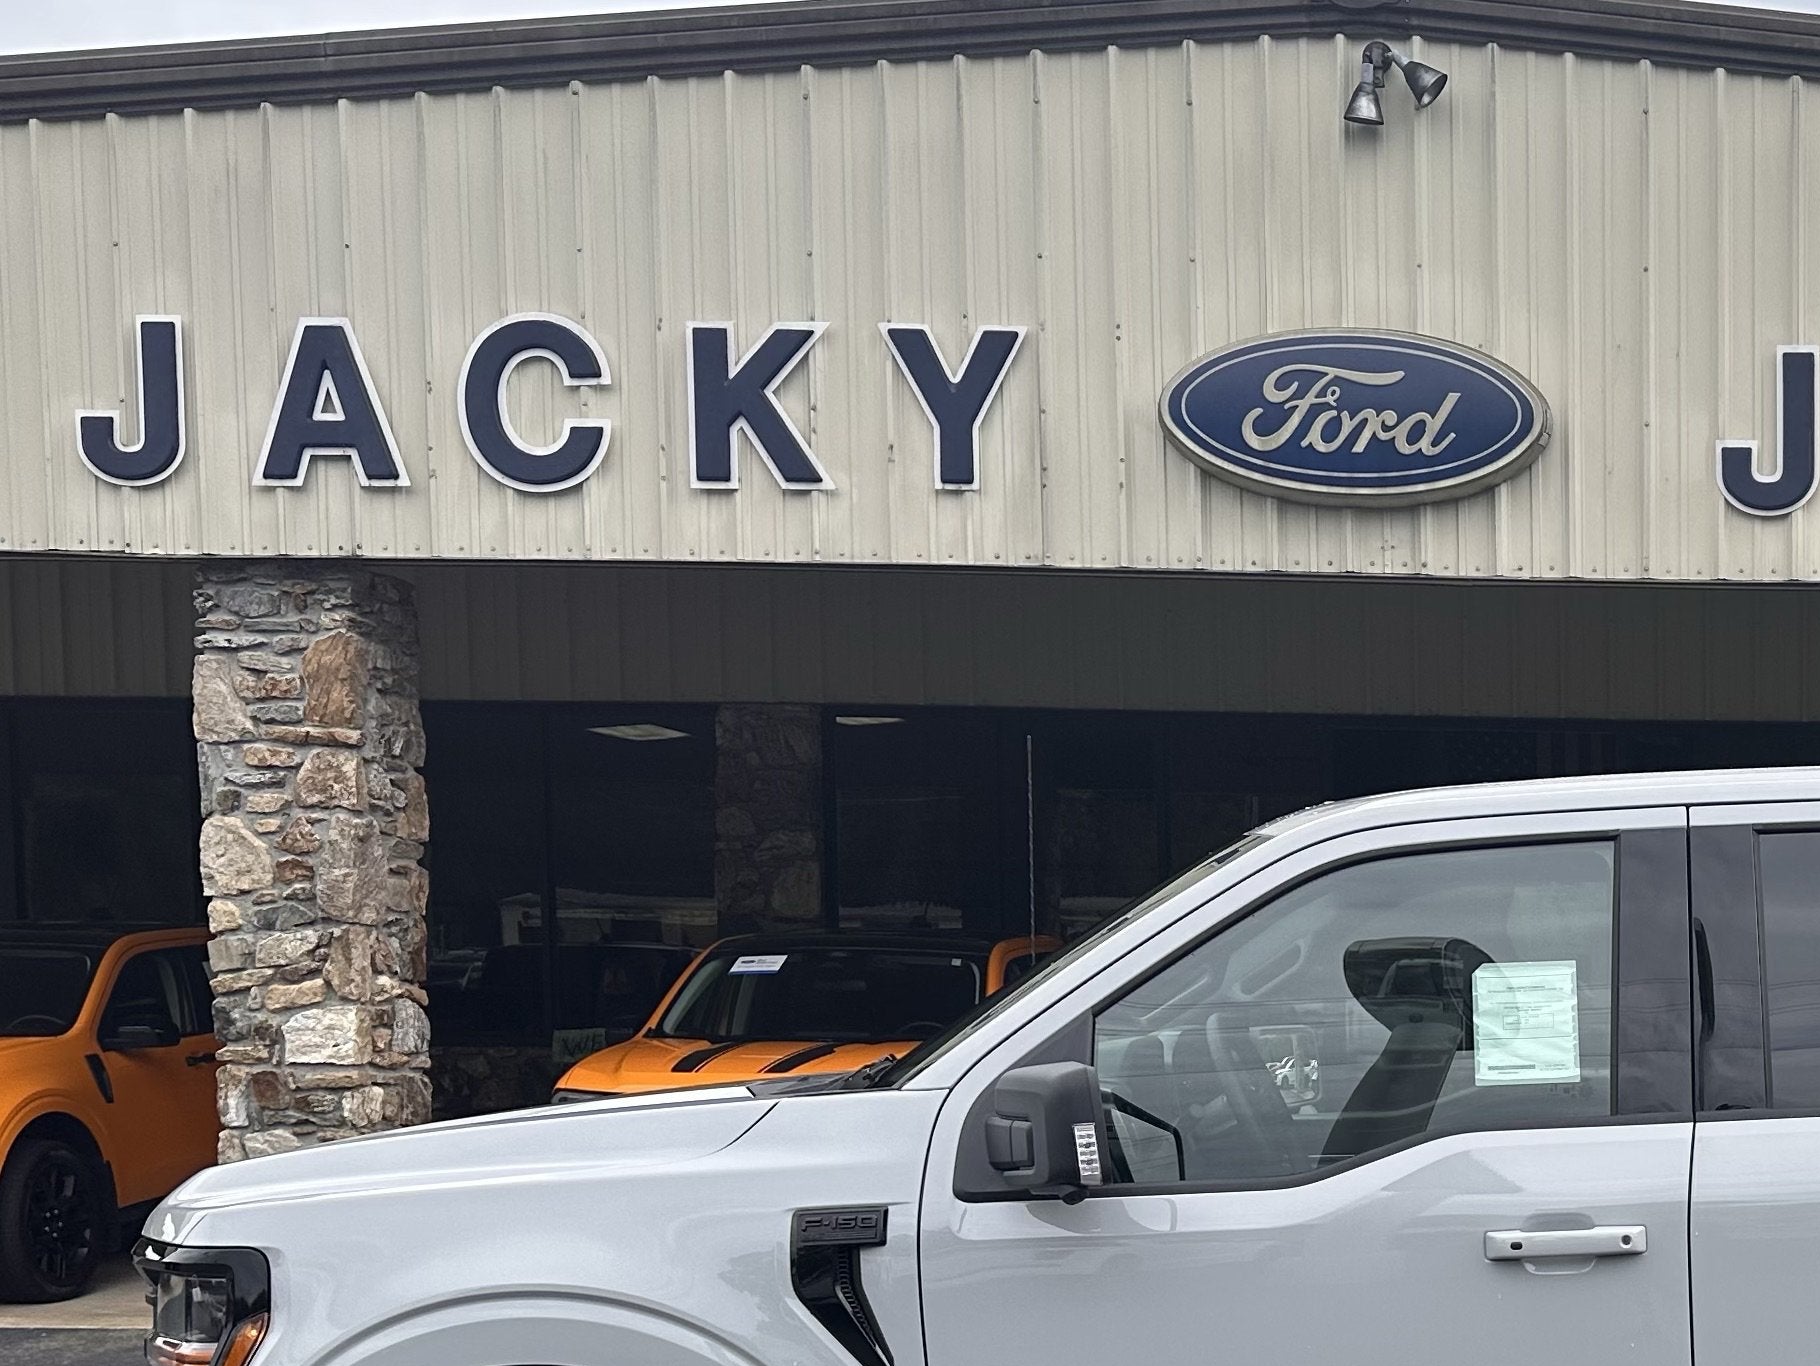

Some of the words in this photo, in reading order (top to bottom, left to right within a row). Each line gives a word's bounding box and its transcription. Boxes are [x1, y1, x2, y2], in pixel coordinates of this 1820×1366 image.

[75, 312, 1028, 493] JACKY
[1242, 364, 1461, 456] Ford
[801, 1214, 878, 1233] F-150
